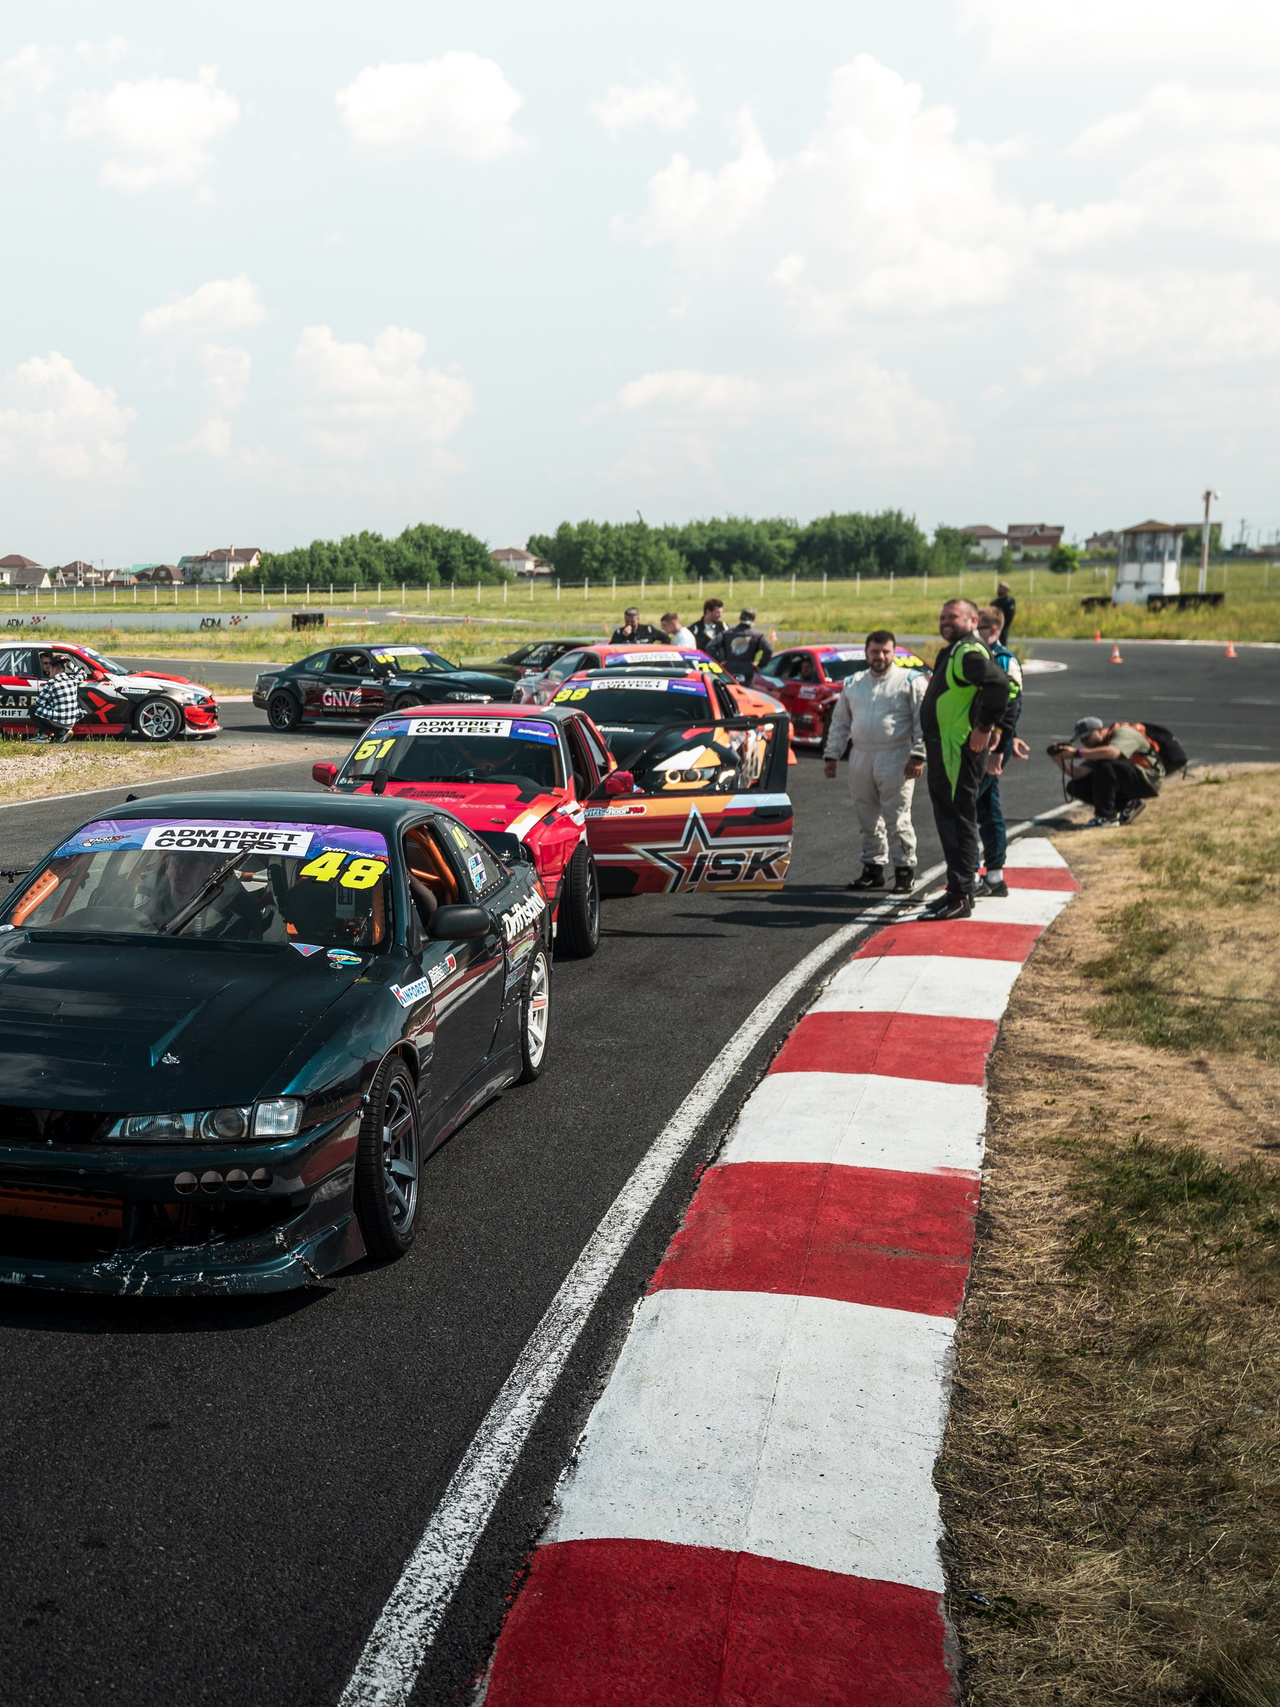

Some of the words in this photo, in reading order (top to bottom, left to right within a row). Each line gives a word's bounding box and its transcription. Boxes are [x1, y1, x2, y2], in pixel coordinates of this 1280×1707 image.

[7, 619, 24, 628] ADM
[200, 618, 221, 628] ADM
[322, 689, 353, 707] GNV
[552, 687, 590, 702] 98
[415, 726, 505, 734] CONTEST
[353, 738, 396, 761] 51
[159, 829, 220, 838] ADM
[222, 830, 301, 842] DRIFT
[154, 837, 298, 852] CONTEST
[299, 851, 388, 890] 48
[685, 850, 790, 882] ISK
[392, 979, 430, 1005] KINFOREST
